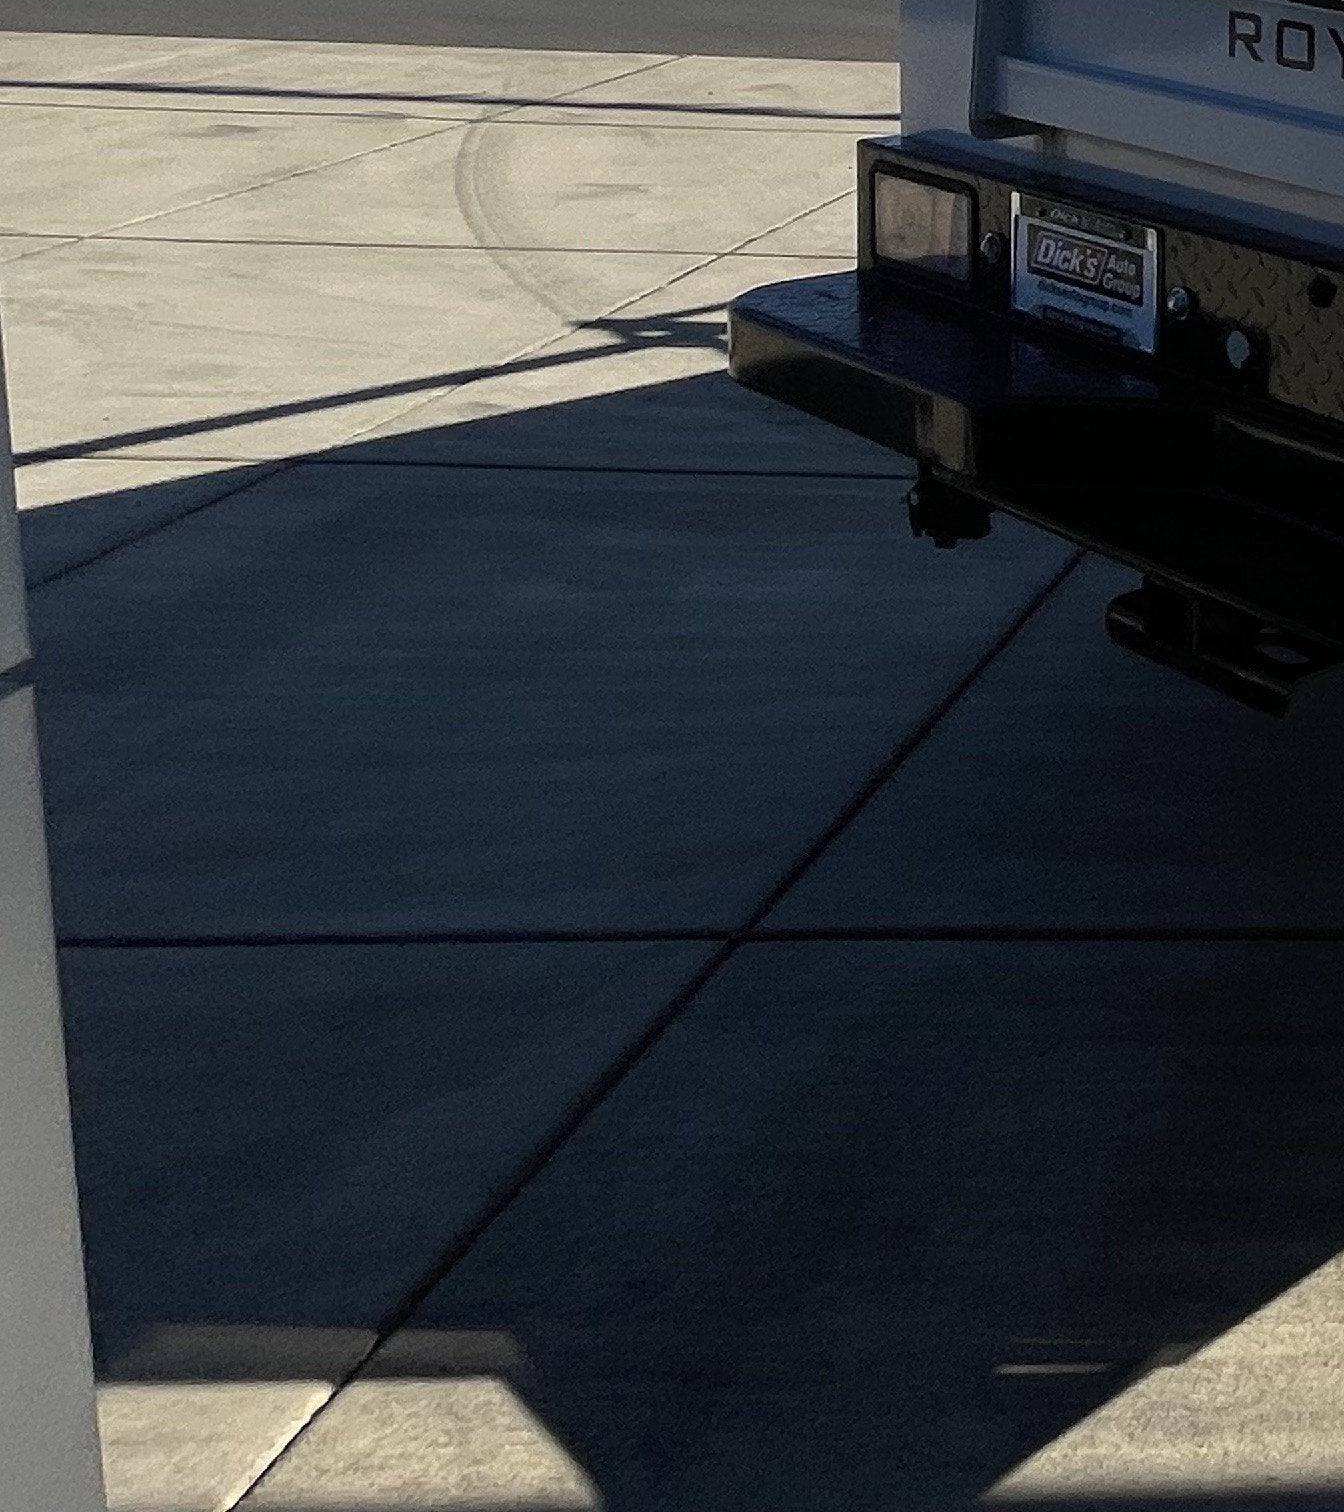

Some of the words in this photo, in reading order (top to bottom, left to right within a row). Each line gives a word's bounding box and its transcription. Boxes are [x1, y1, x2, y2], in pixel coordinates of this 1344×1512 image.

[1036, 238, 1099, 279] Dick's
[1106, 254, 1136, 276] Auto
[1103, 273, 1141, 300] Group
